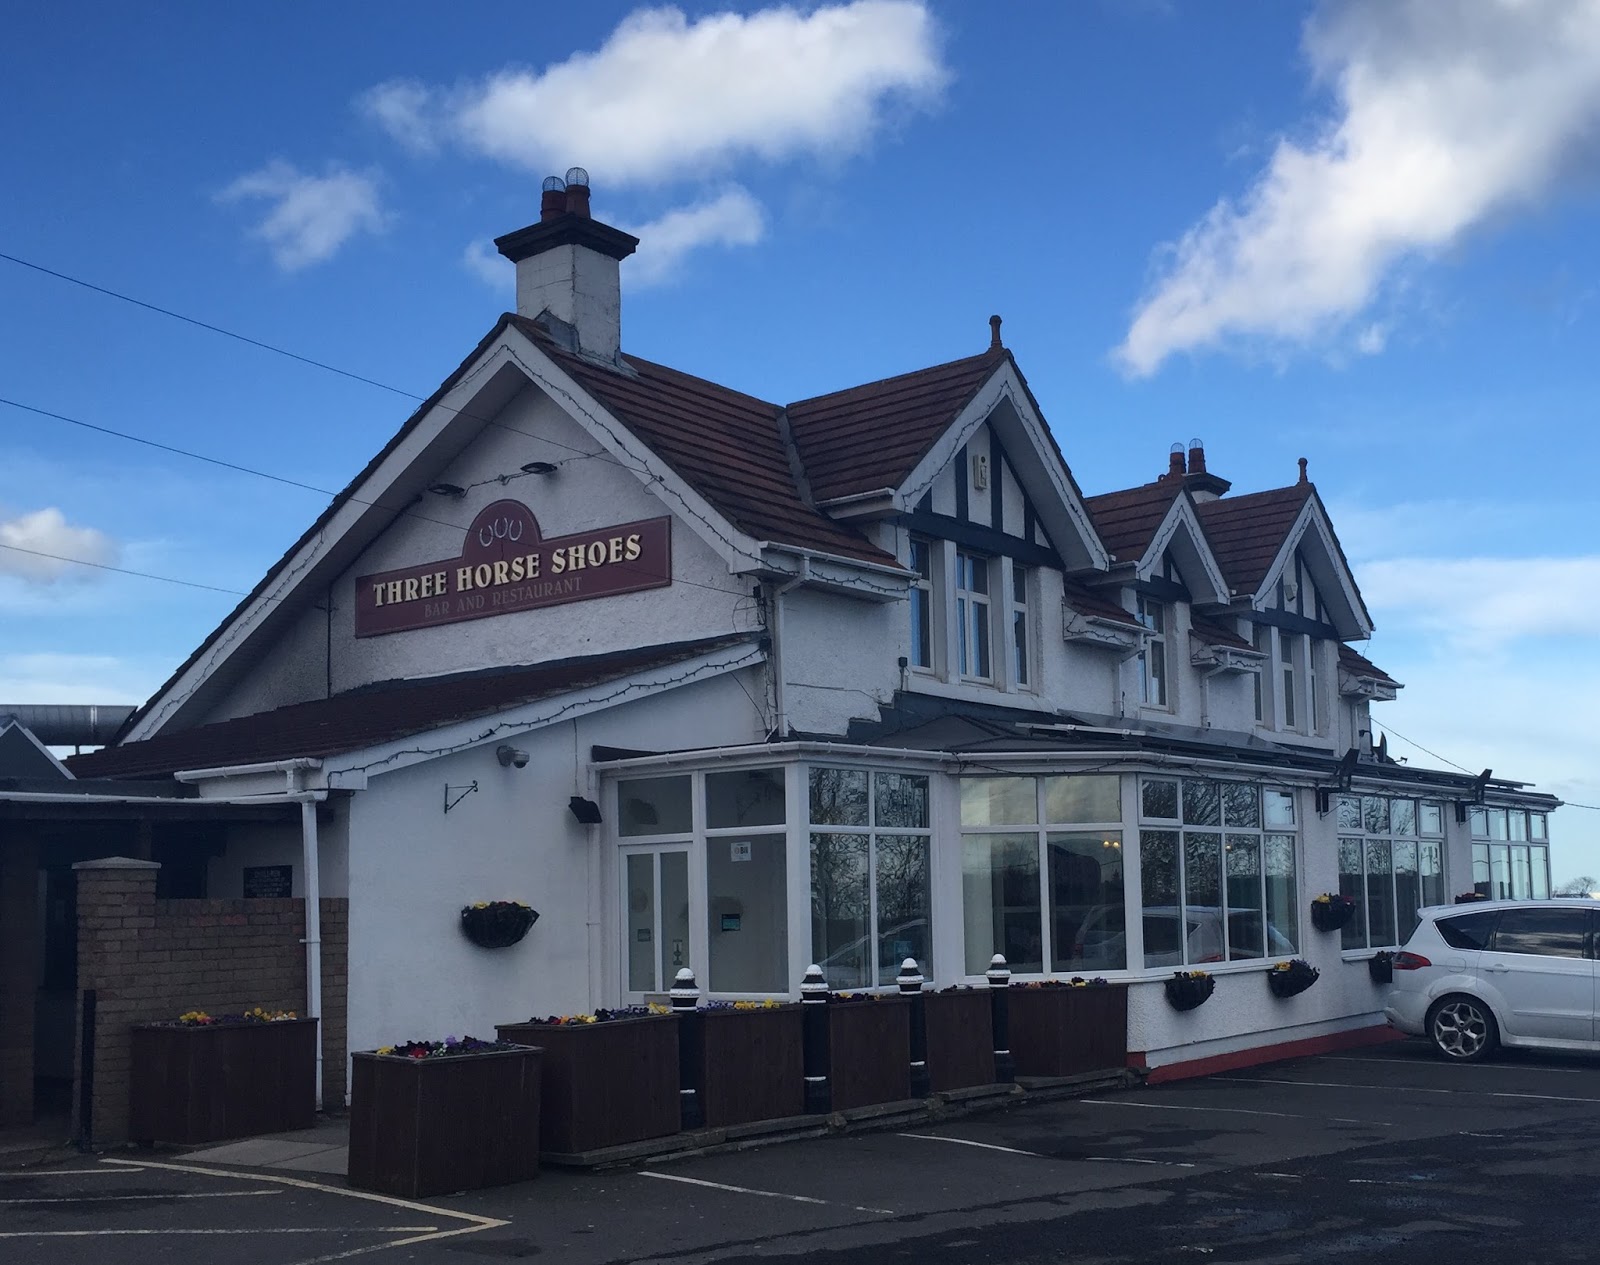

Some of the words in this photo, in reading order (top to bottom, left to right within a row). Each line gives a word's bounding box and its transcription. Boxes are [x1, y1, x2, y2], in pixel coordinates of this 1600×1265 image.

[373, 571, 447, 607] THREE
[456, 553, 540, 593] HORSE
[551, 534, 642, 574] SHOES
[424, 600, 450, 618] BAR
[457, 593, 485, 612] AND
[492, 576, 583, 607] RESTAURANT
